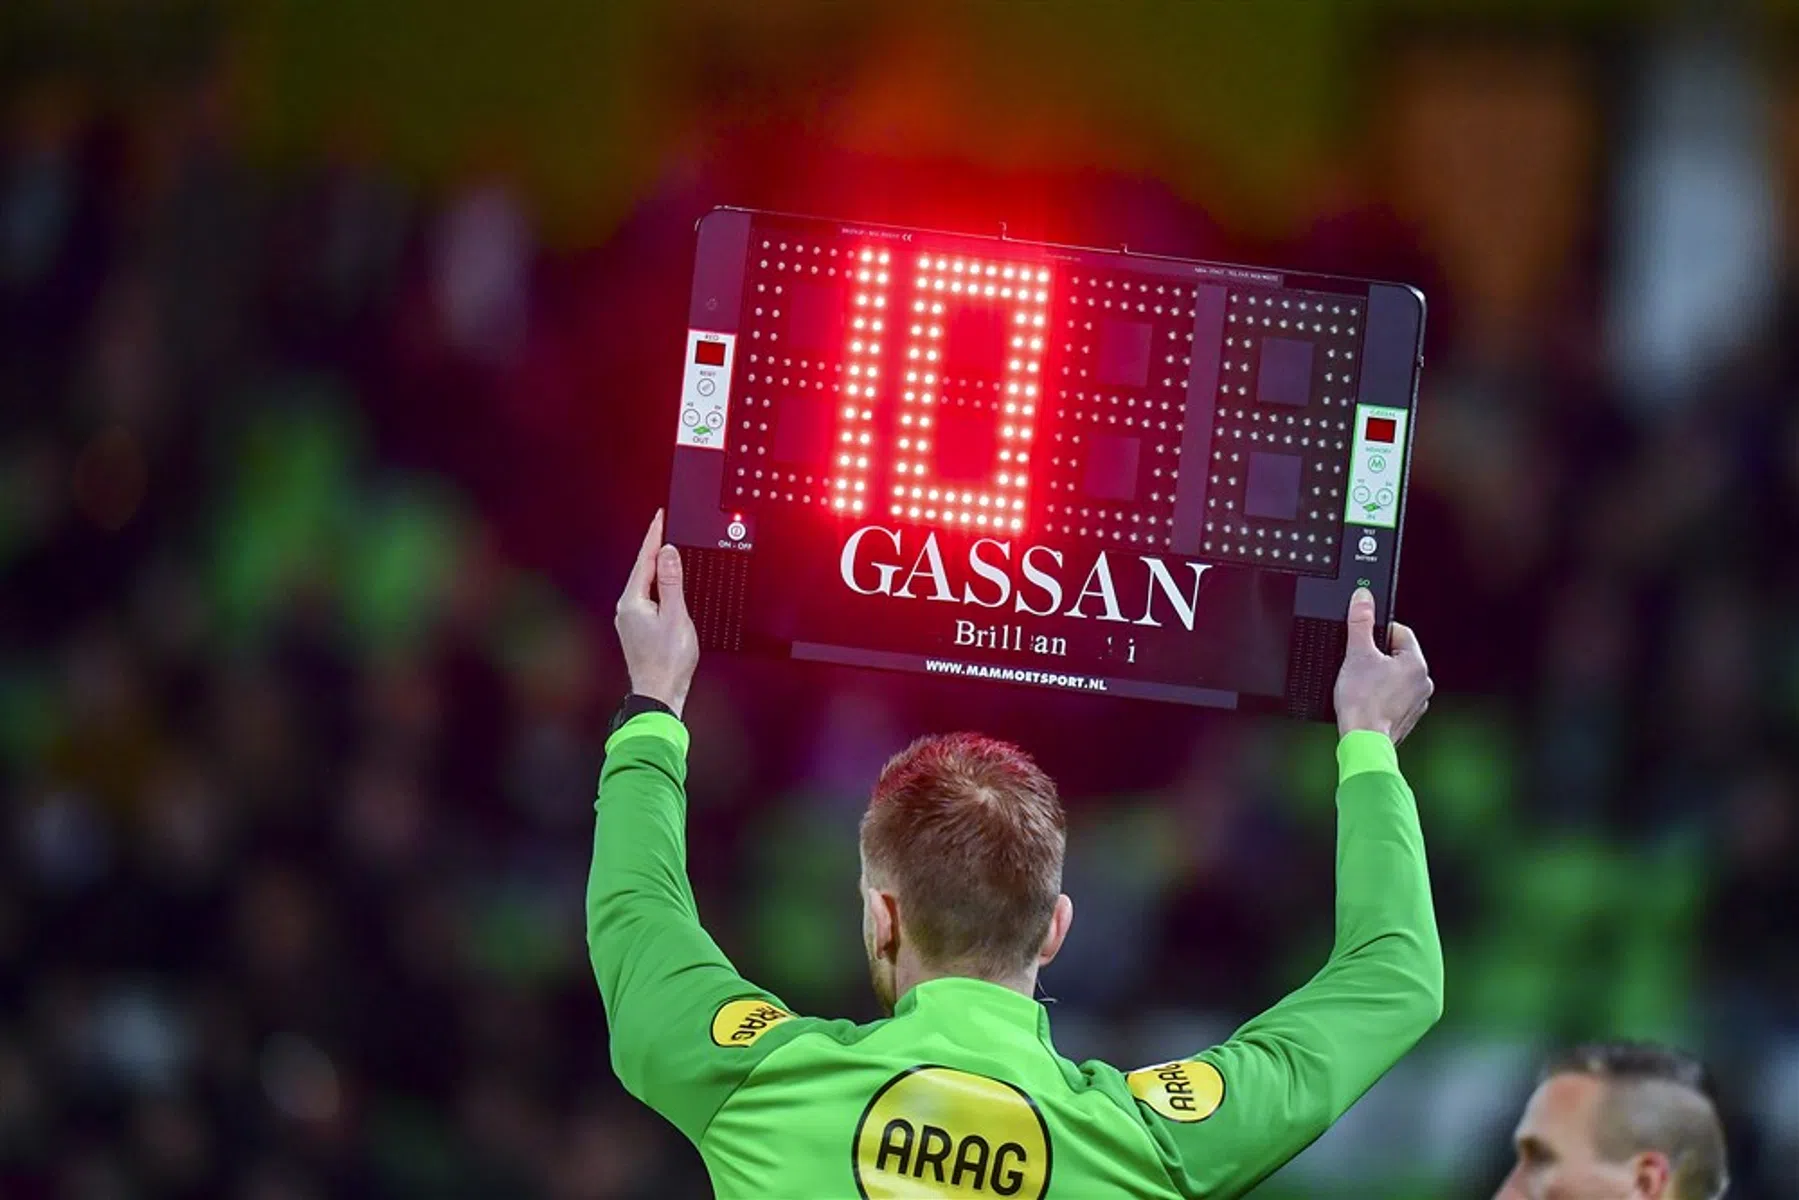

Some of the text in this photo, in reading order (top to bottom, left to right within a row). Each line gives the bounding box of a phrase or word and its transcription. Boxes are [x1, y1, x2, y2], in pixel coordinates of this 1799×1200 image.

[833, 250, 1049, 531] 10
[692, 436, 709, 445] OUT
[718, 539, 731, 549] ON
[738, 541, 753, 550] OFF
[839, 525, 1213, 631] GASSAN
[1356, 577, 1371, 587] GO
[925, 660, 1108, 691] WWW.MAMMOETSPORT.NL
[876, 1118, 1027, 1196] ARAG
